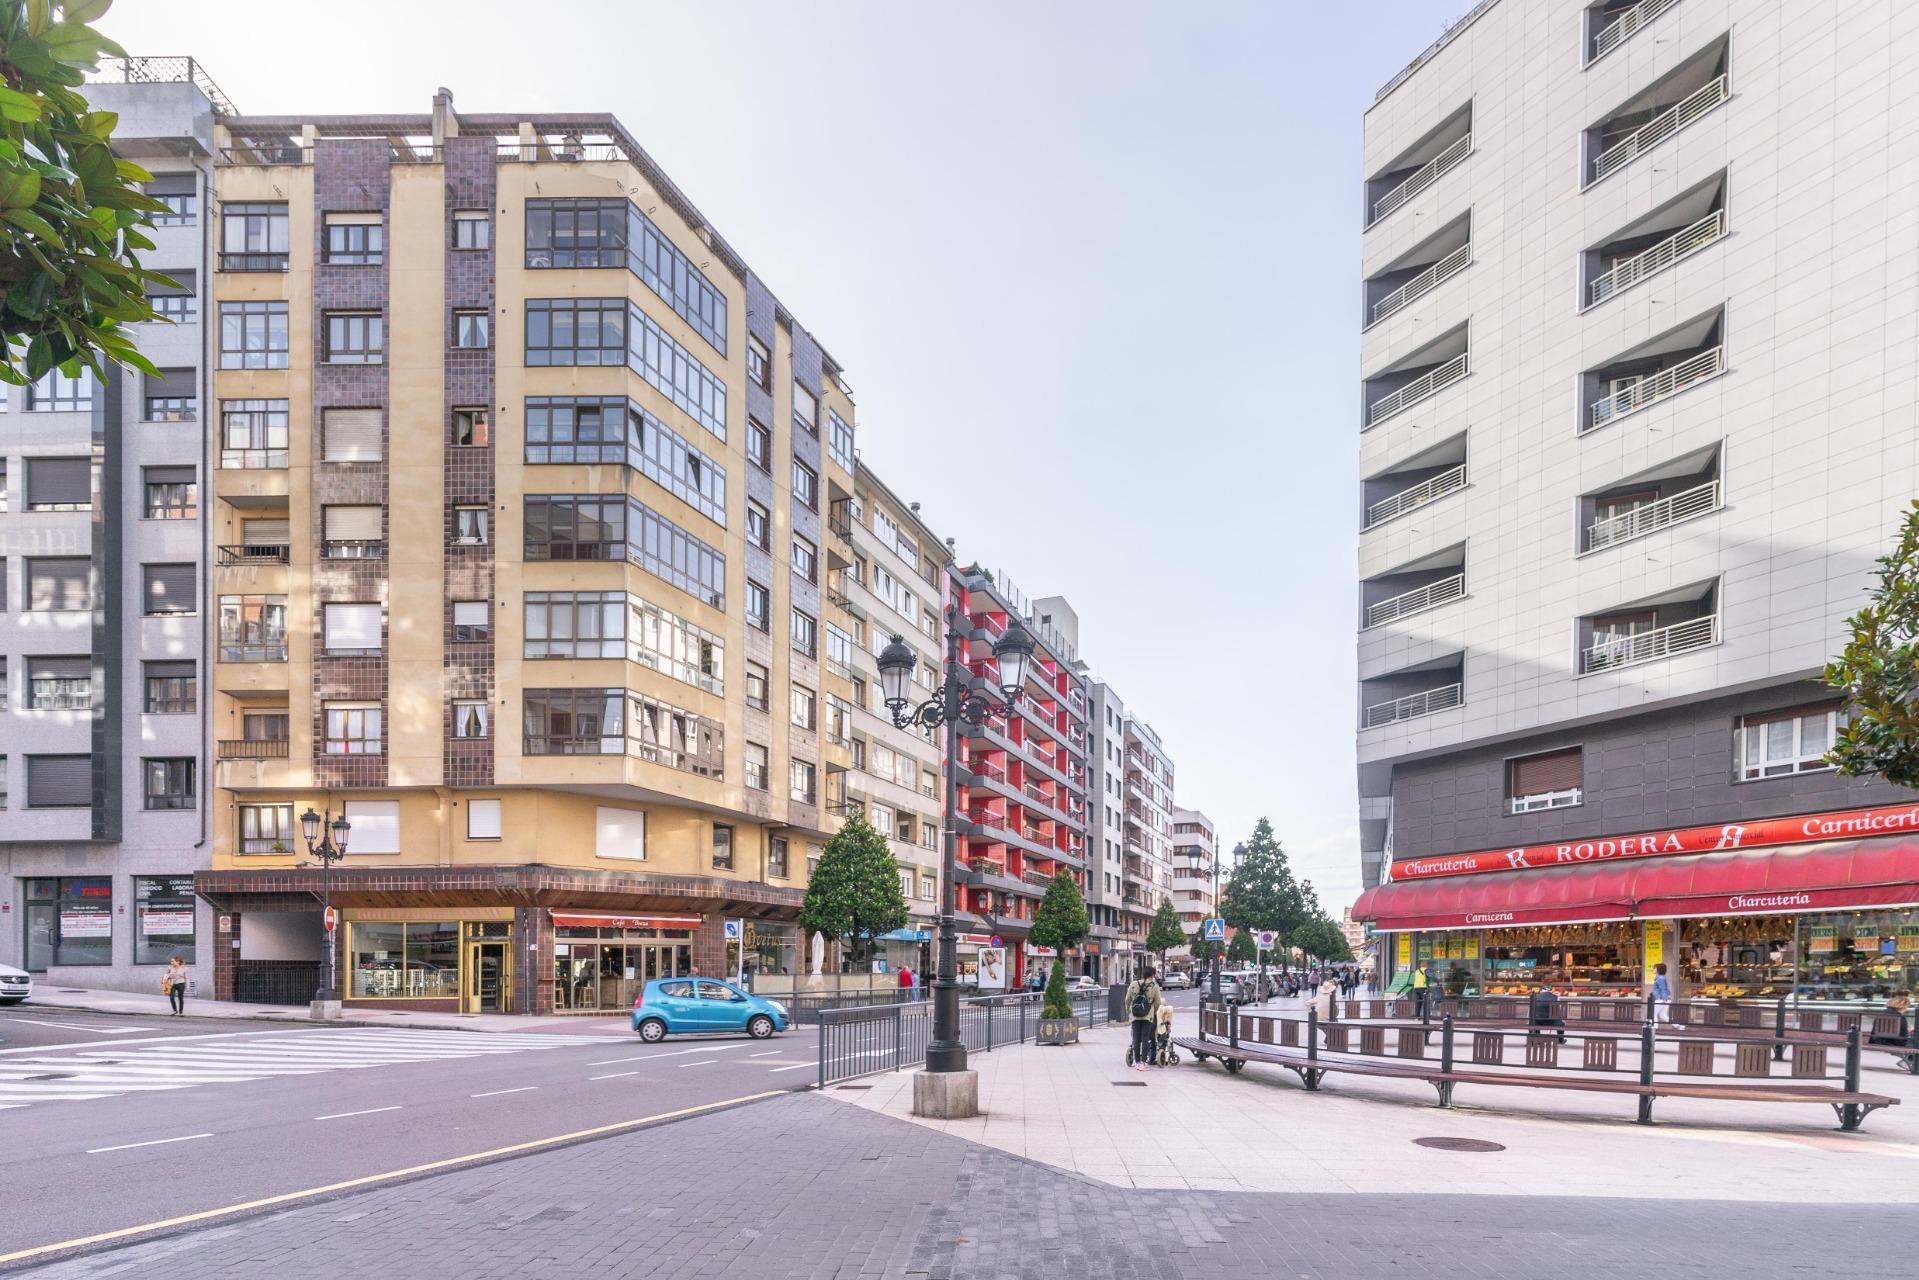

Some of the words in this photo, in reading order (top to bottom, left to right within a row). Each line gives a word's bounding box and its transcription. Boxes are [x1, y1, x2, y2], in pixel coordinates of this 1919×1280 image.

[1405, 856, 1477, 875] Charcutería
[1557, 833, 1685, 862] RODERA
[1728, 892, 1810, 909] Charcutería
